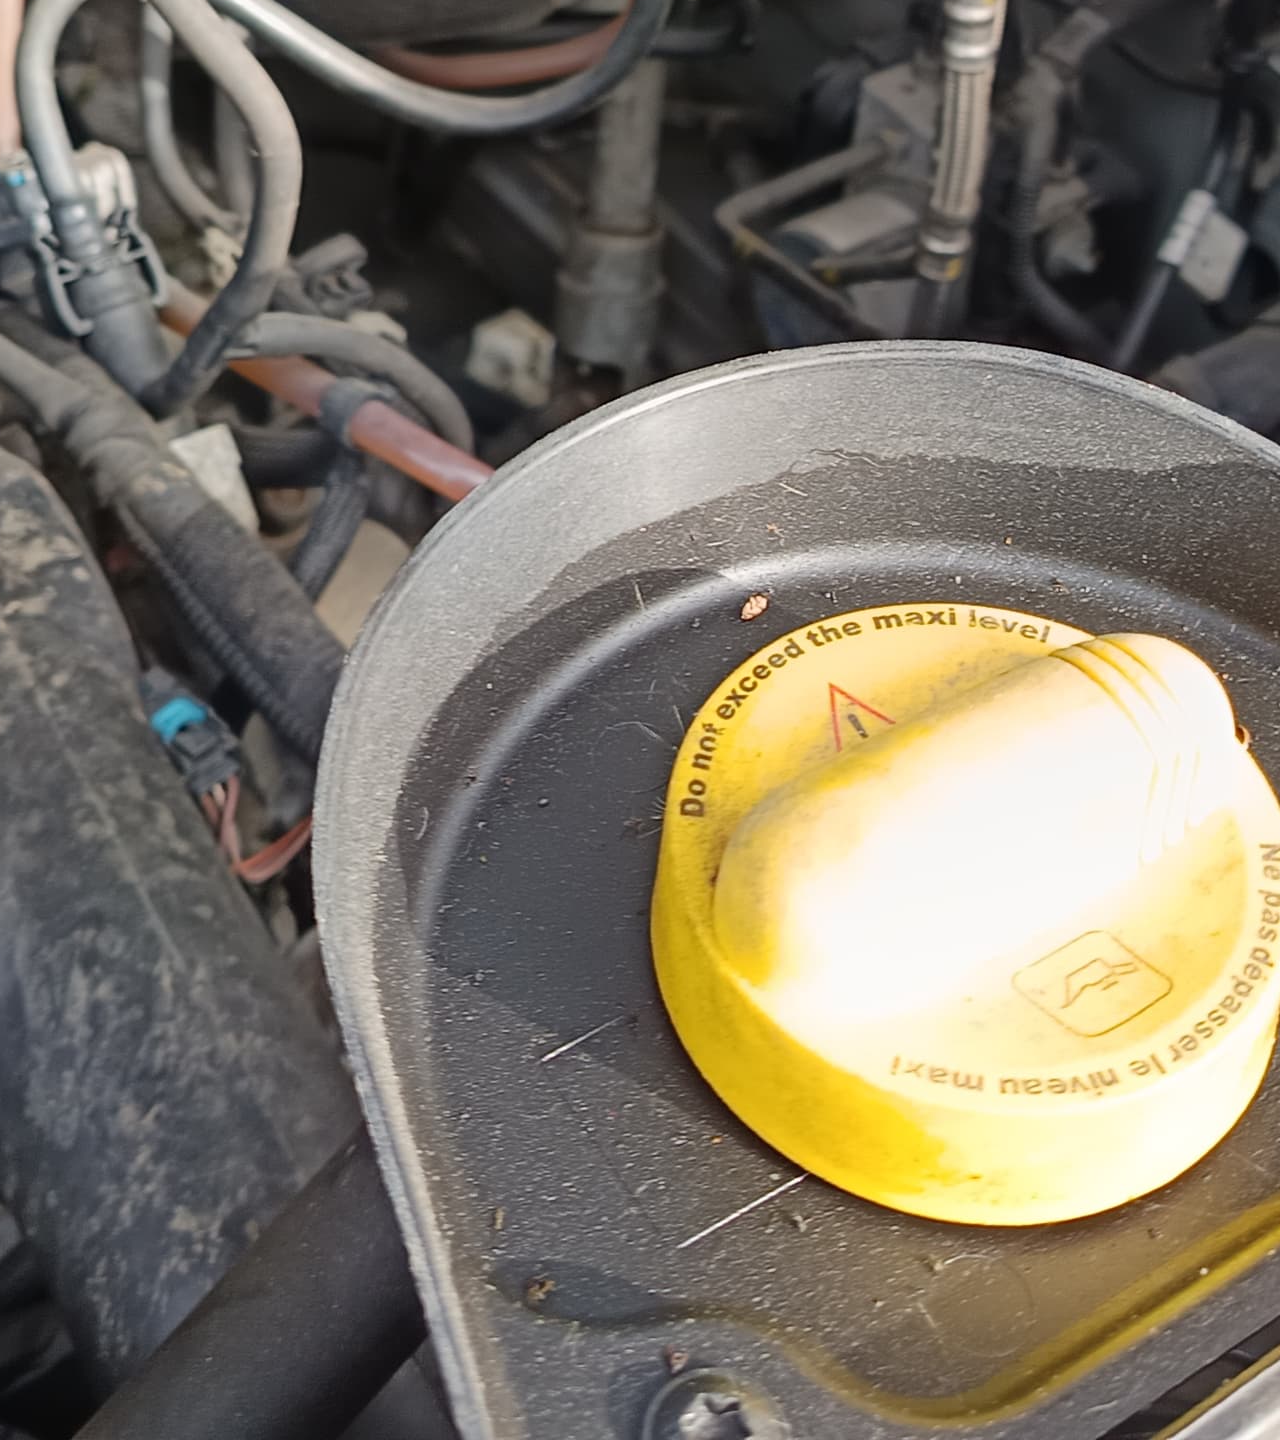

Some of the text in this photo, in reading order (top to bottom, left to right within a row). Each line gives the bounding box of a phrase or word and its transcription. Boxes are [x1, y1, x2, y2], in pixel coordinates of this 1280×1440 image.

[680, 608, 1051, 817] Do not exceed the maxi level
[889, 1055, 984, 1091] maxi
[1128, 1053, 1166, 1076] le
[1000, 1068, 1120, 1096] niveau
